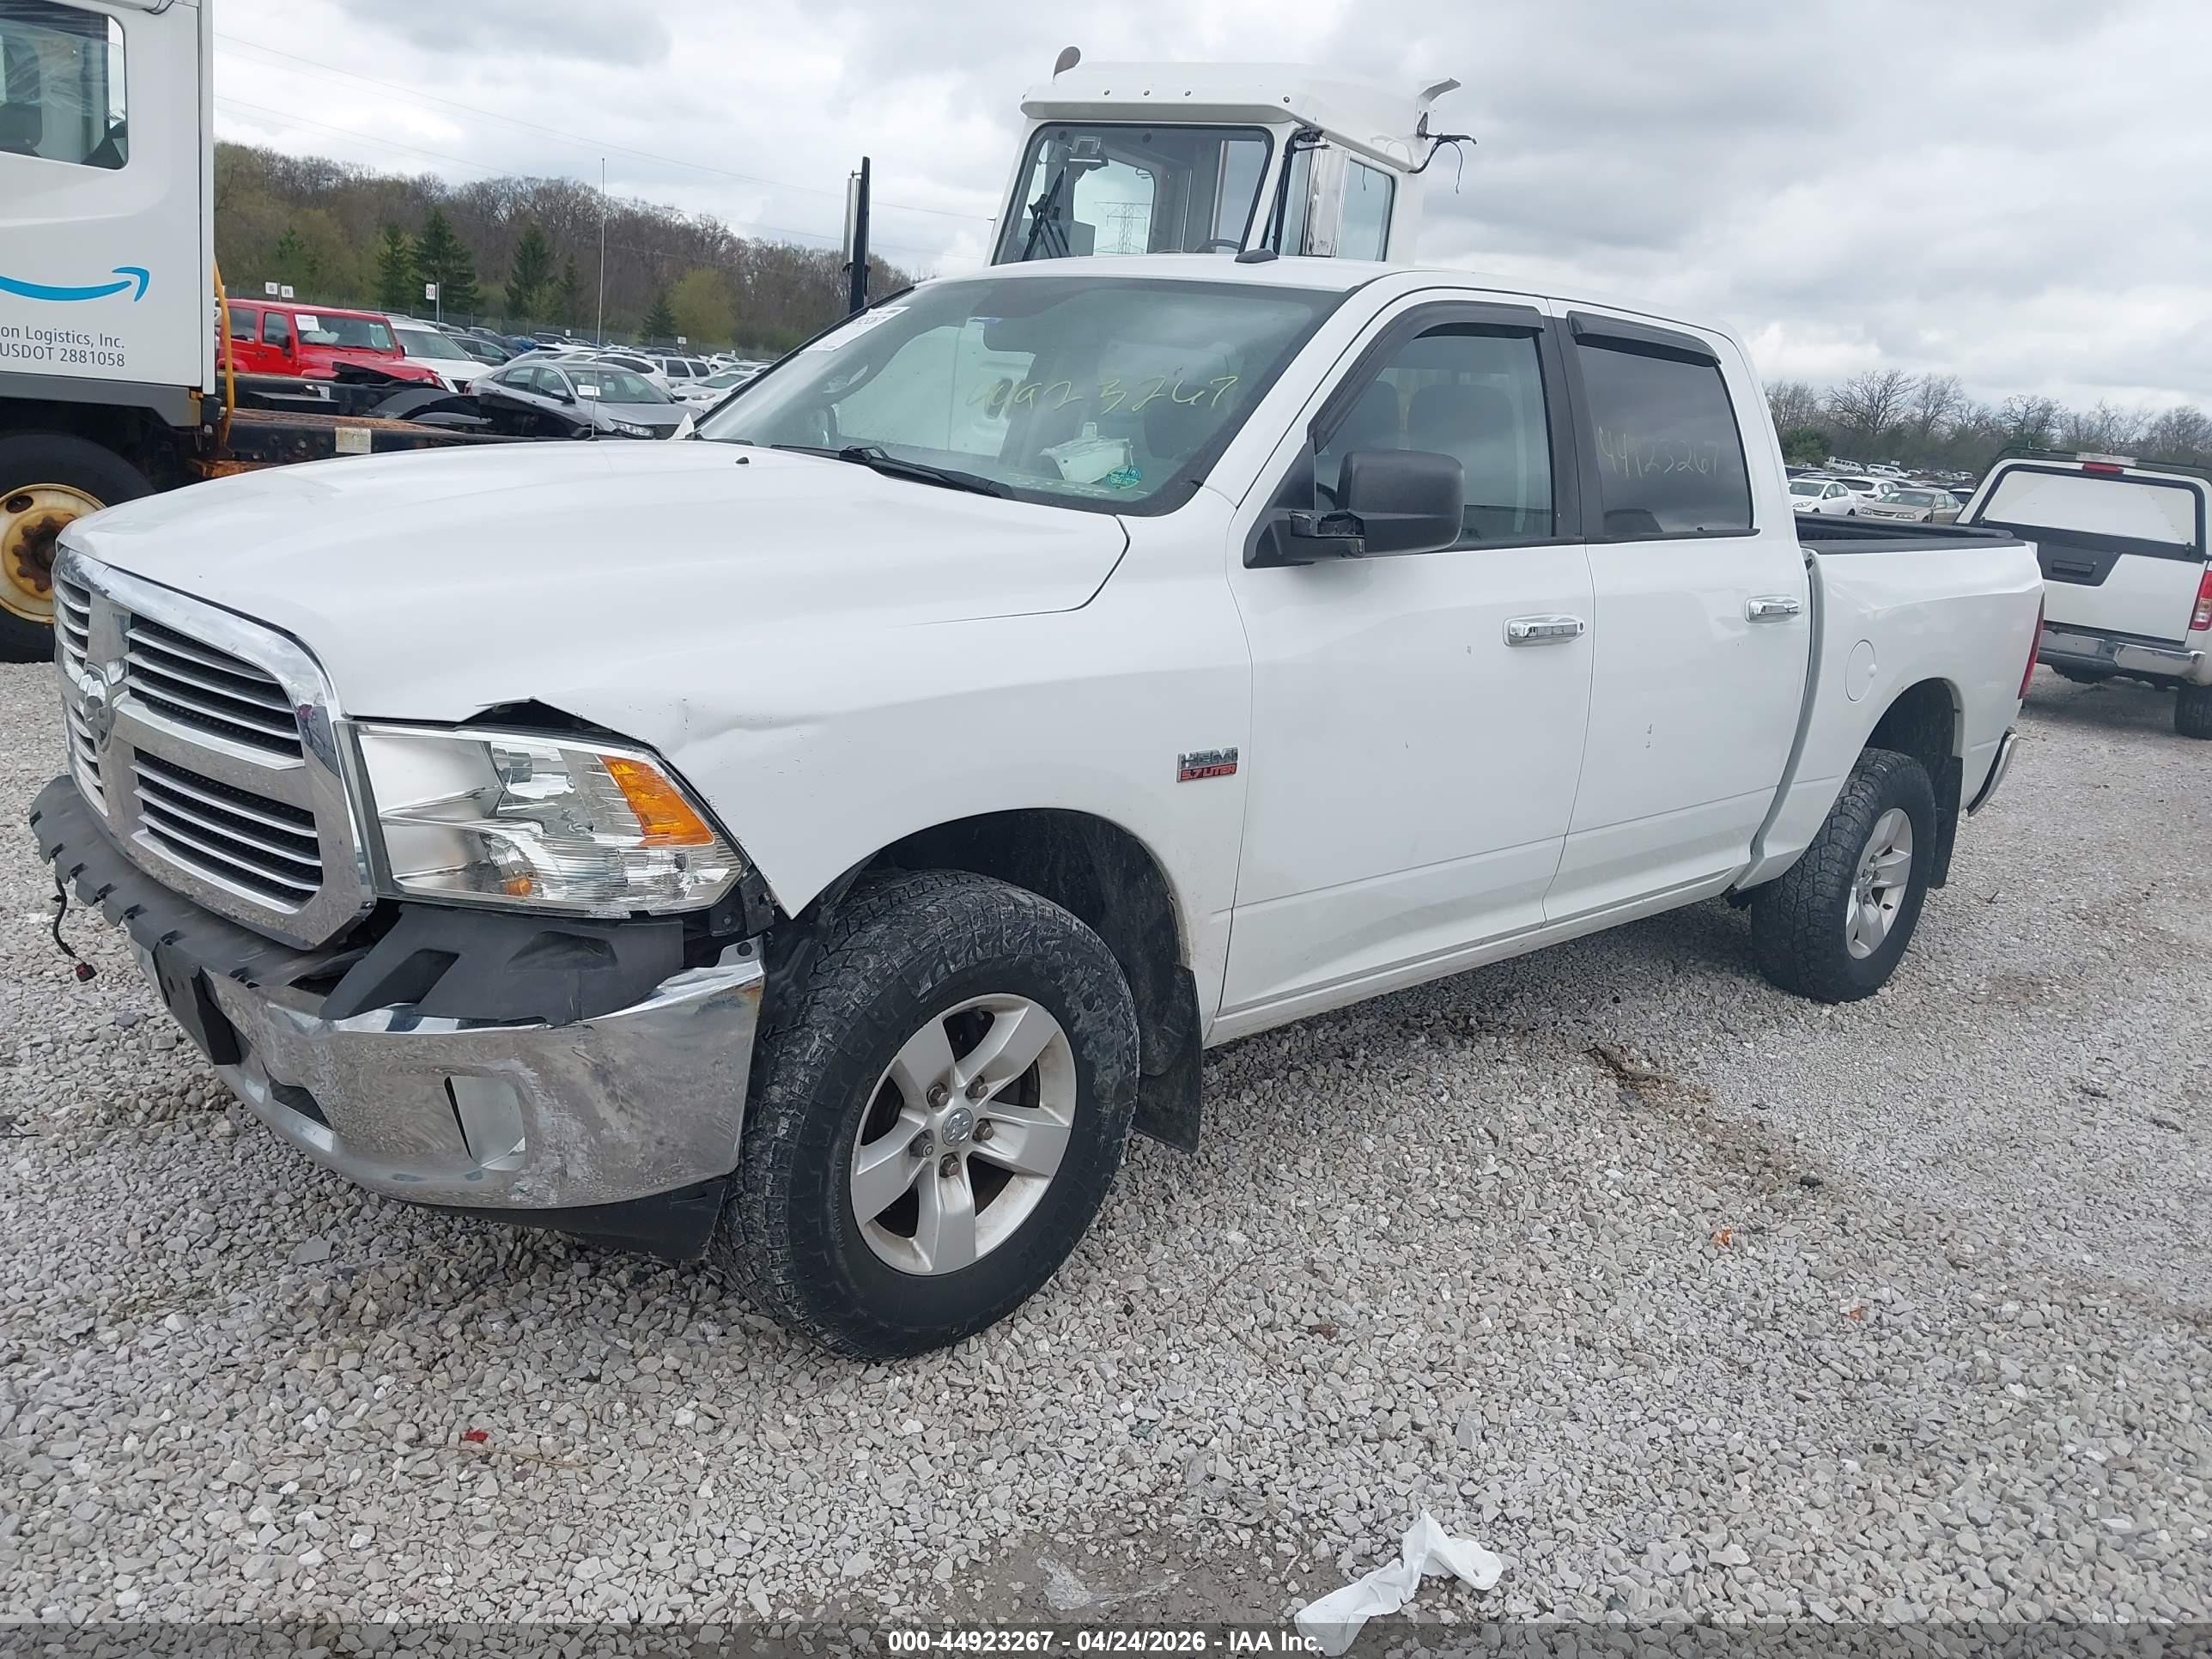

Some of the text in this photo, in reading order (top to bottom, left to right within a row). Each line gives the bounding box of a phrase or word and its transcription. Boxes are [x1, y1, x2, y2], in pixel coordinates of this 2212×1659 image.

[426, 287, 434, 296] 20
[25, 325, 94, 348] Logistics,
[99, 332, 125, 349] Inc.
[0, 342, 125, 368] USDOT 2881058
[1177, 746, 1238, 769] HEMI
[1182, 763, 1237, 781] 5.7 LITER
